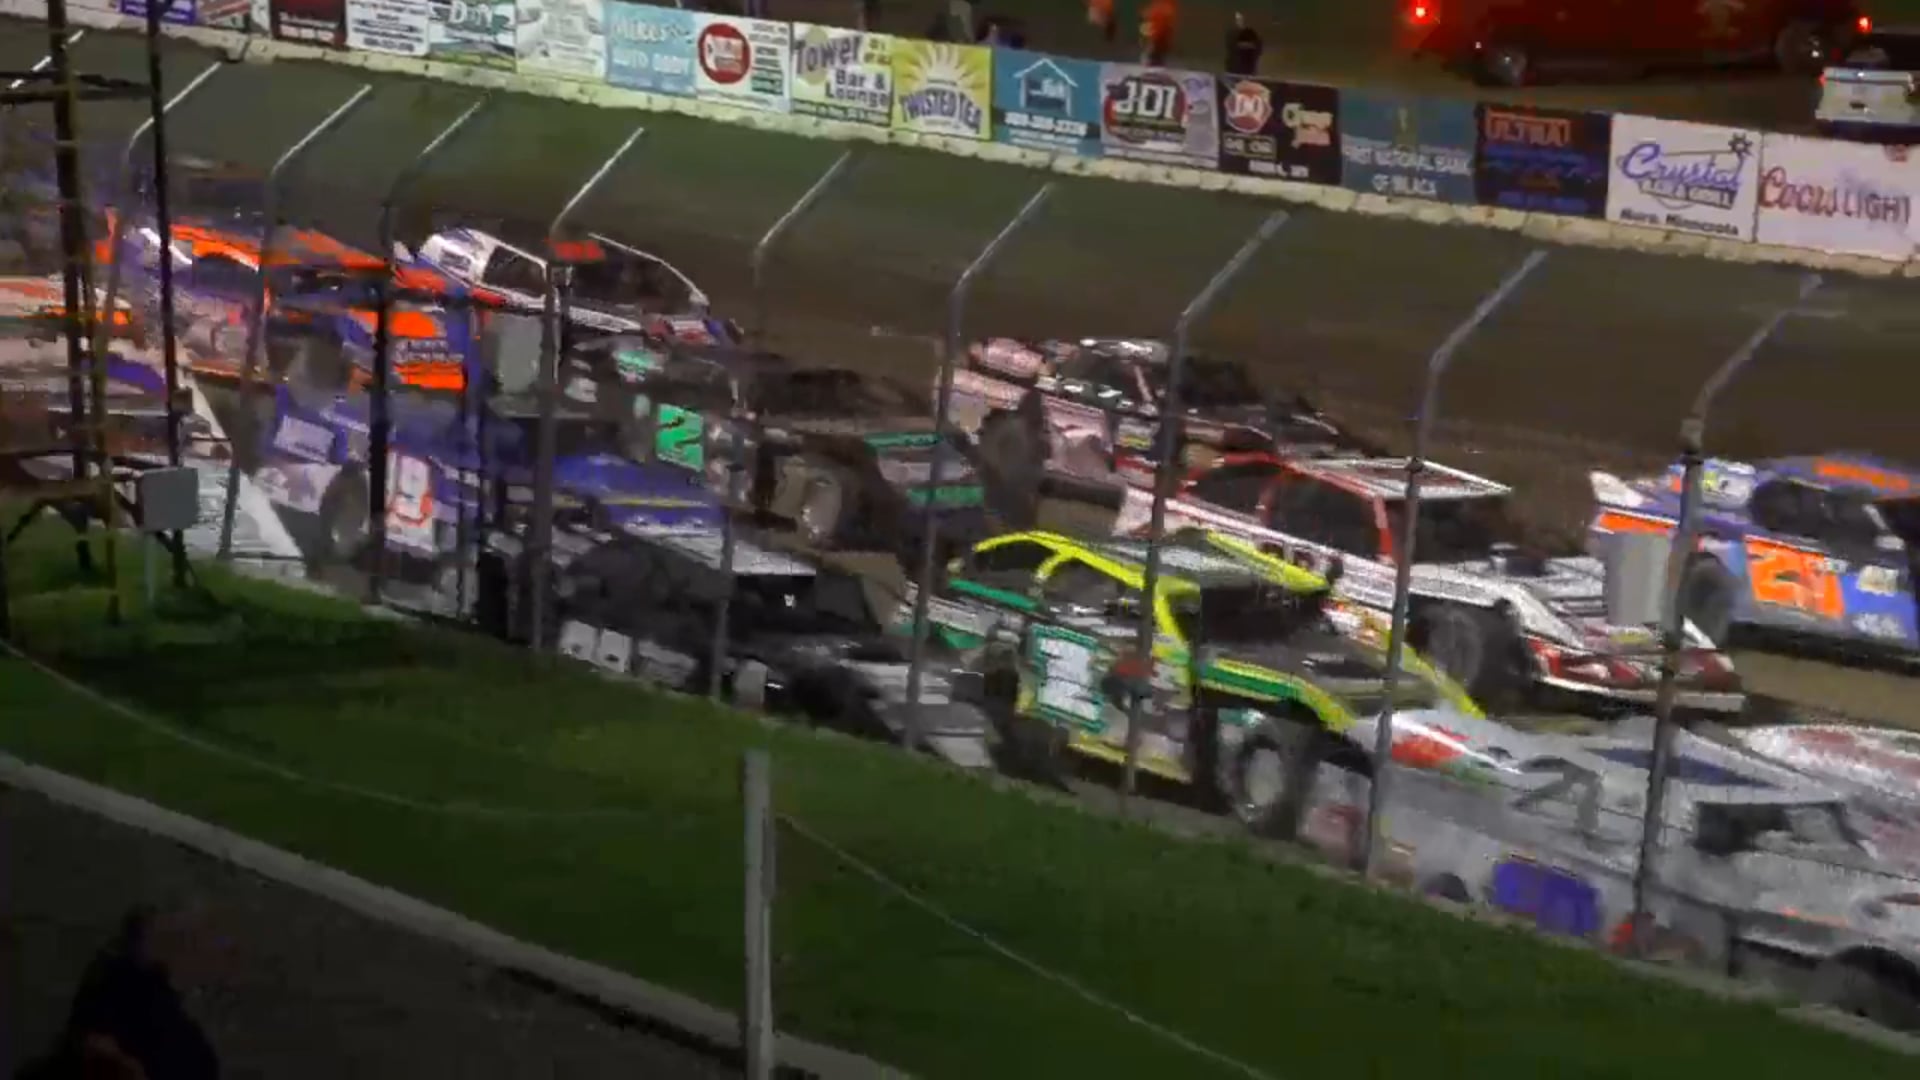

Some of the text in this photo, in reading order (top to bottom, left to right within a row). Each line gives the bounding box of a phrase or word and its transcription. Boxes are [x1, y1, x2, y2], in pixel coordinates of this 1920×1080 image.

[792, 37, 863, 74] Tower
[826, 83, 890, 107] Lounge
[836, 69, 885, 89] Bar &
[1622, 143, 1741, 192] Crystal
[1843, 188, 1911, 225] LIGHT
